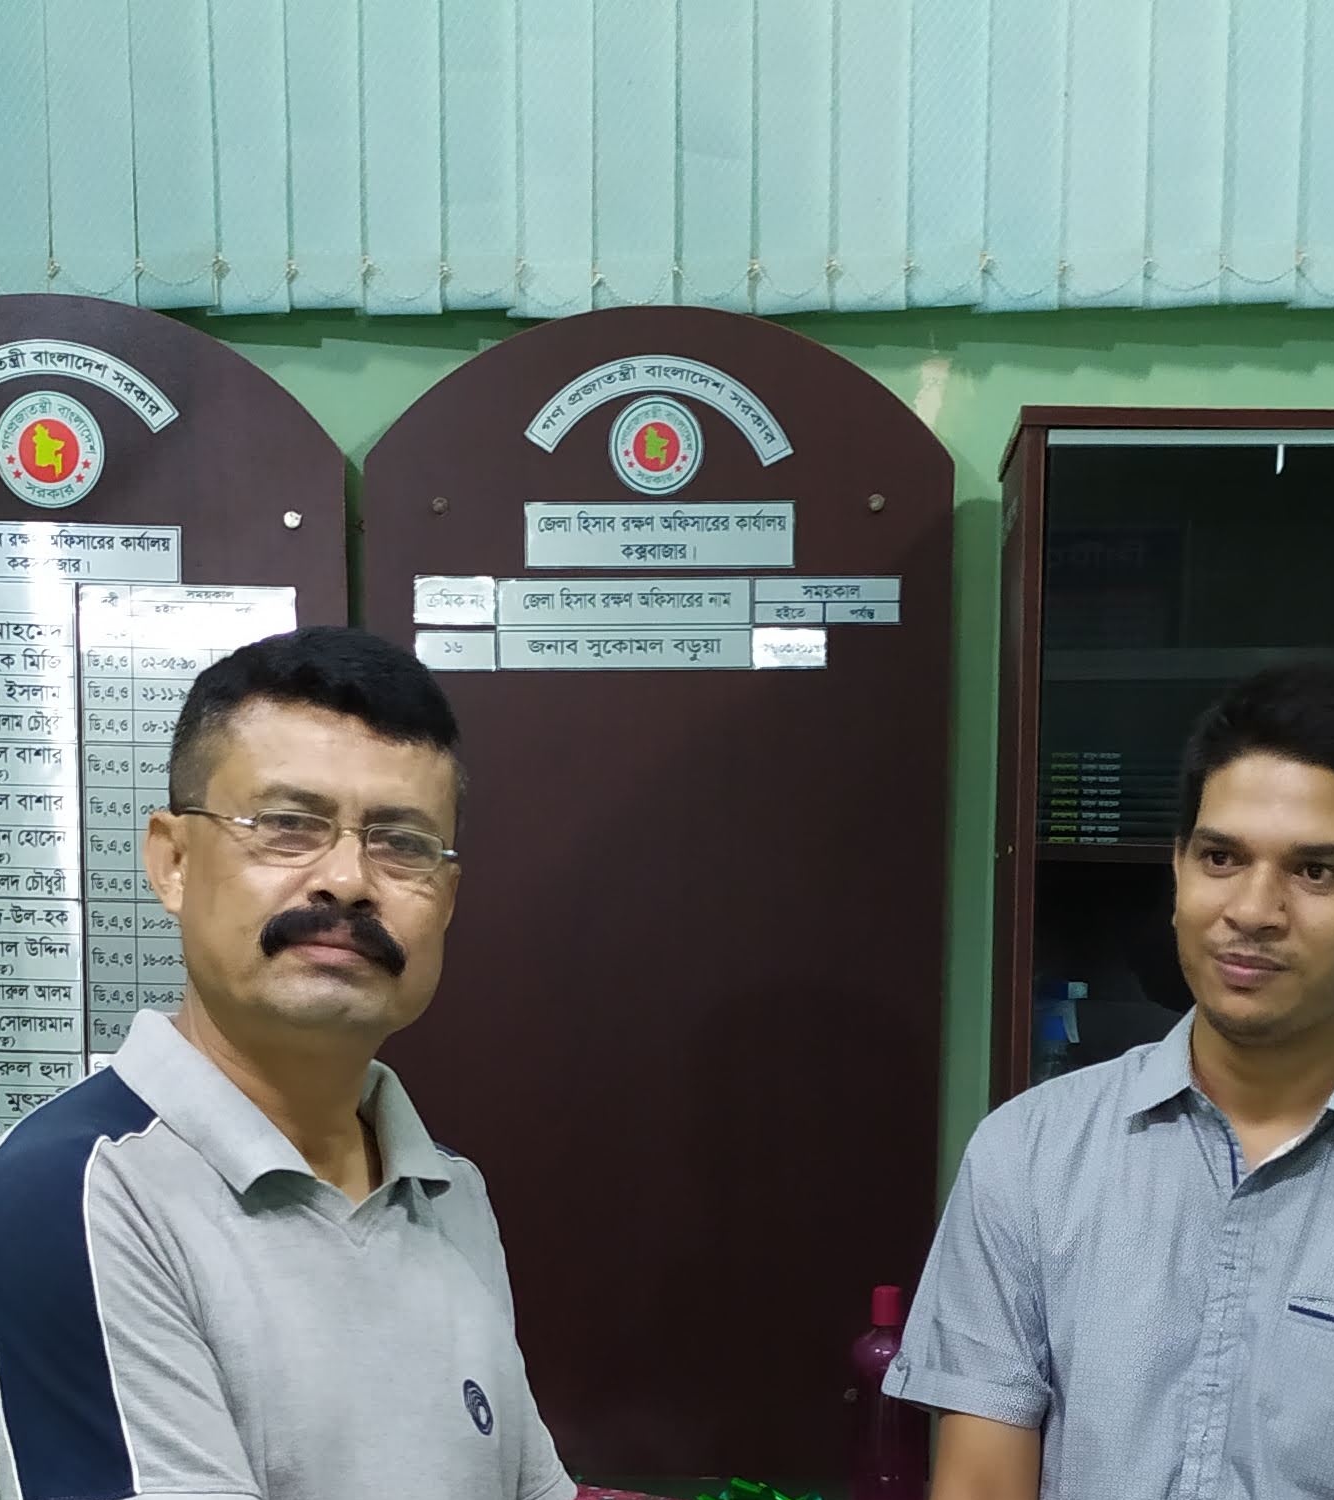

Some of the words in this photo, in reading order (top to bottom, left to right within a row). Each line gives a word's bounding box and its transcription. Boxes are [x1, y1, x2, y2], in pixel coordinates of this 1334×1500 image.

[30, 350, 109, 380] বাংলাদেশ
[112, 368, 164, 418] সরকার
[541, 405, 566, 432] গণ
[643, 364, 726, 395] বাংলাদেশ
[729, 389, 777, 445] সরকার
[56, 402, 98, 455] বাংলাদেশ
[24, 481, 76, 500] সরকার
[538, 515, 572, 533] জেলা
[576, 511, 616, 536] হিসাব
[620, 515, 655, 533] রক্ষণ
[659, 510, 730, 533] অফিসারের
[734, 509, 788, 533] কার্যালয়
[119, 531, 172, 553] কার্যালয়
[522, 592, 555, 610] জেলা
[559, 587, 596, 611] হিসাব
[601, 592, 633, 610] রক্ষণ
[636, 586, 704, 609] অফিসারের
[708, 592, 732, 609] নাম
[443, 641, 464, 655] ১৬
[527, 639, 579, 656] জনাব
[585, 639, 664, 659] সুকোমল
[15, 746, 63, 766] বাশার
[15, 793, 64, 812] বাশার
[17, 828, 67, 848] হোসেন
[25, 868, 67, 896] চৌধুরী
[24, 936, 71, 960] উদ্দিন
[33, 985, 73, 1002] আলম
[39, 1061, 74, 1081] হুদা
